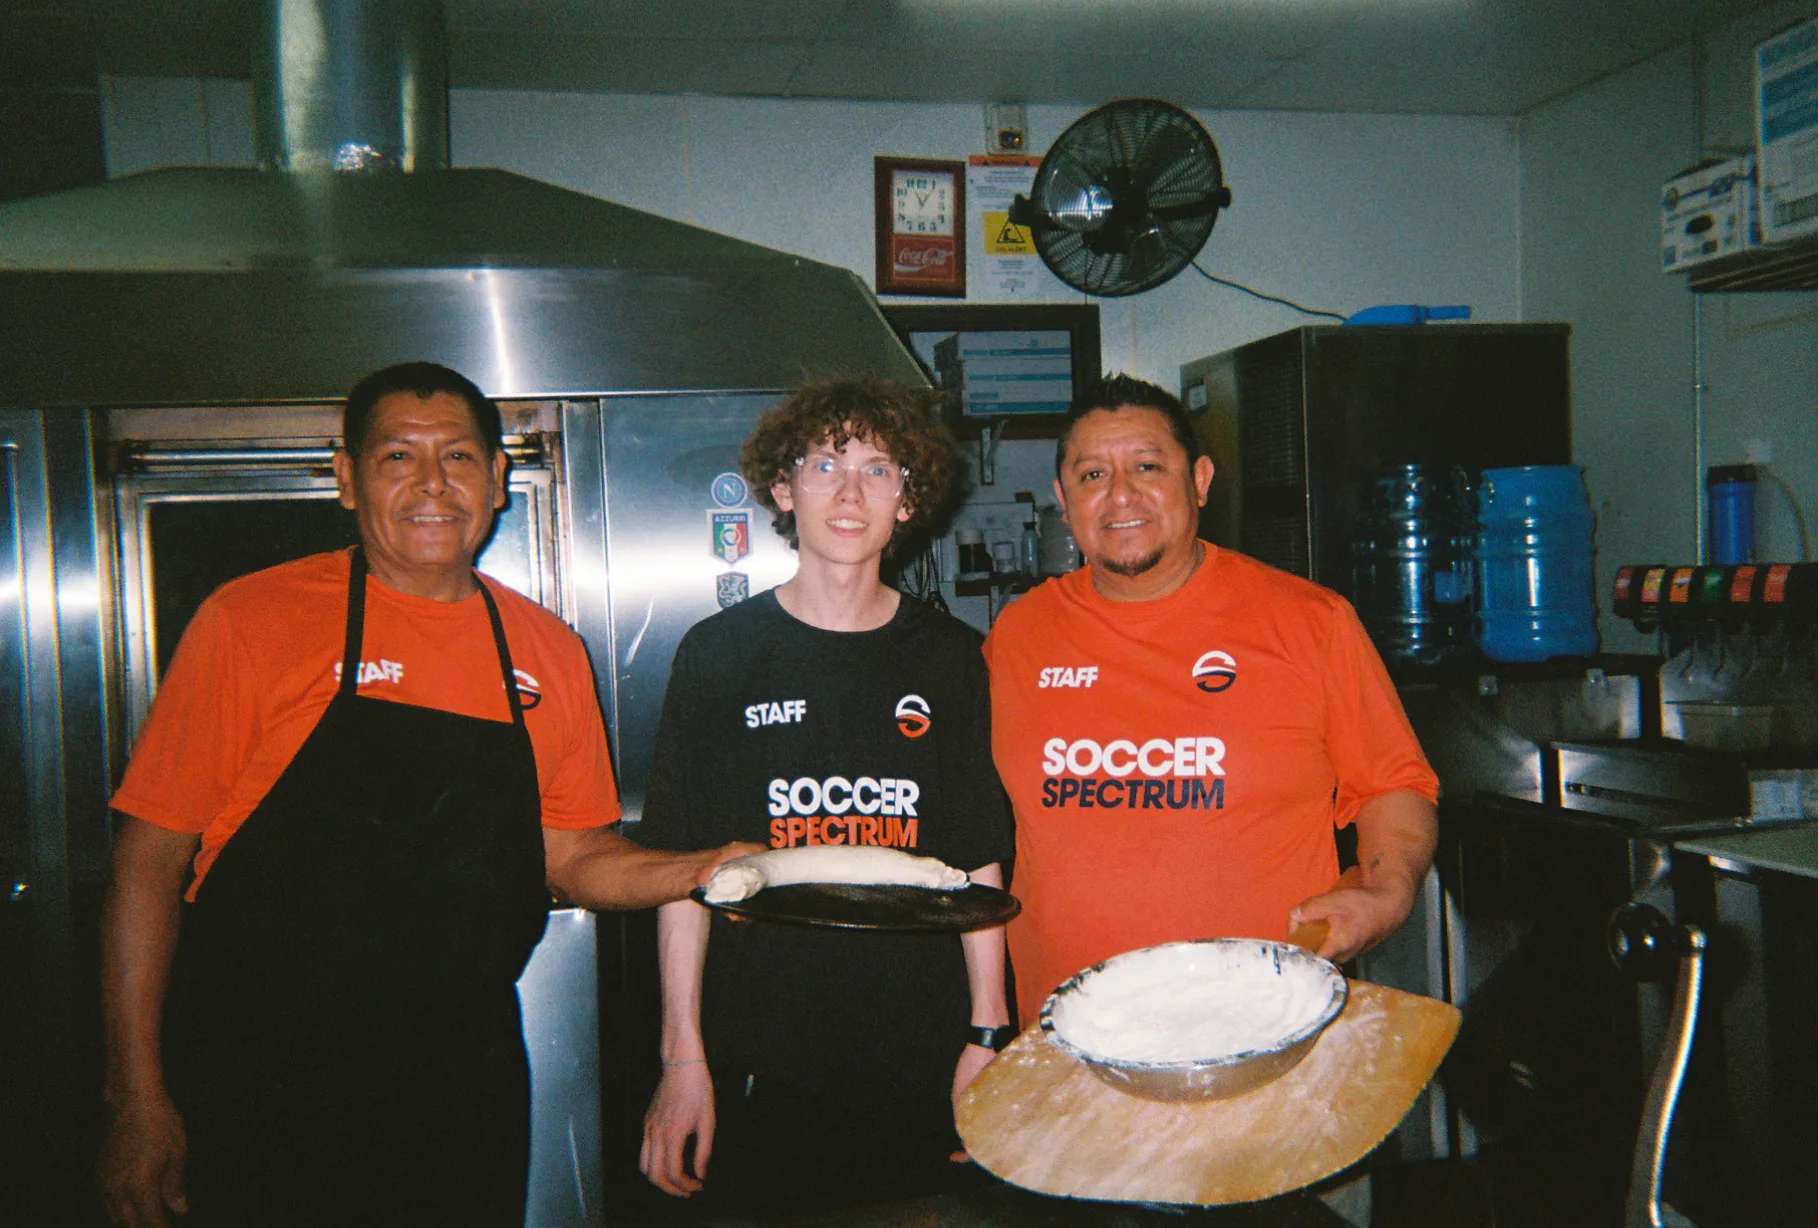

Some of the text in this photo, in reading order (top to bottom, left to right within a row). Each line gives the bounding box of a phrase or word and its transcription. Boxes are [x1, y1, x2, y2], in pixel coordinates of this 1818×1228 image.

[723, 482, 737, 498] N
[1038, 666, 1099, 689] STAFF
[744, 699, 807, 728] STAFF
[1041, 736, 1227, 777] SOCCER
[768, 775, 920, 817] SOCCER
[1041, 777, 1225, 810] SPECTRUM
[769, 815, 919, 849] SPECTRUM
